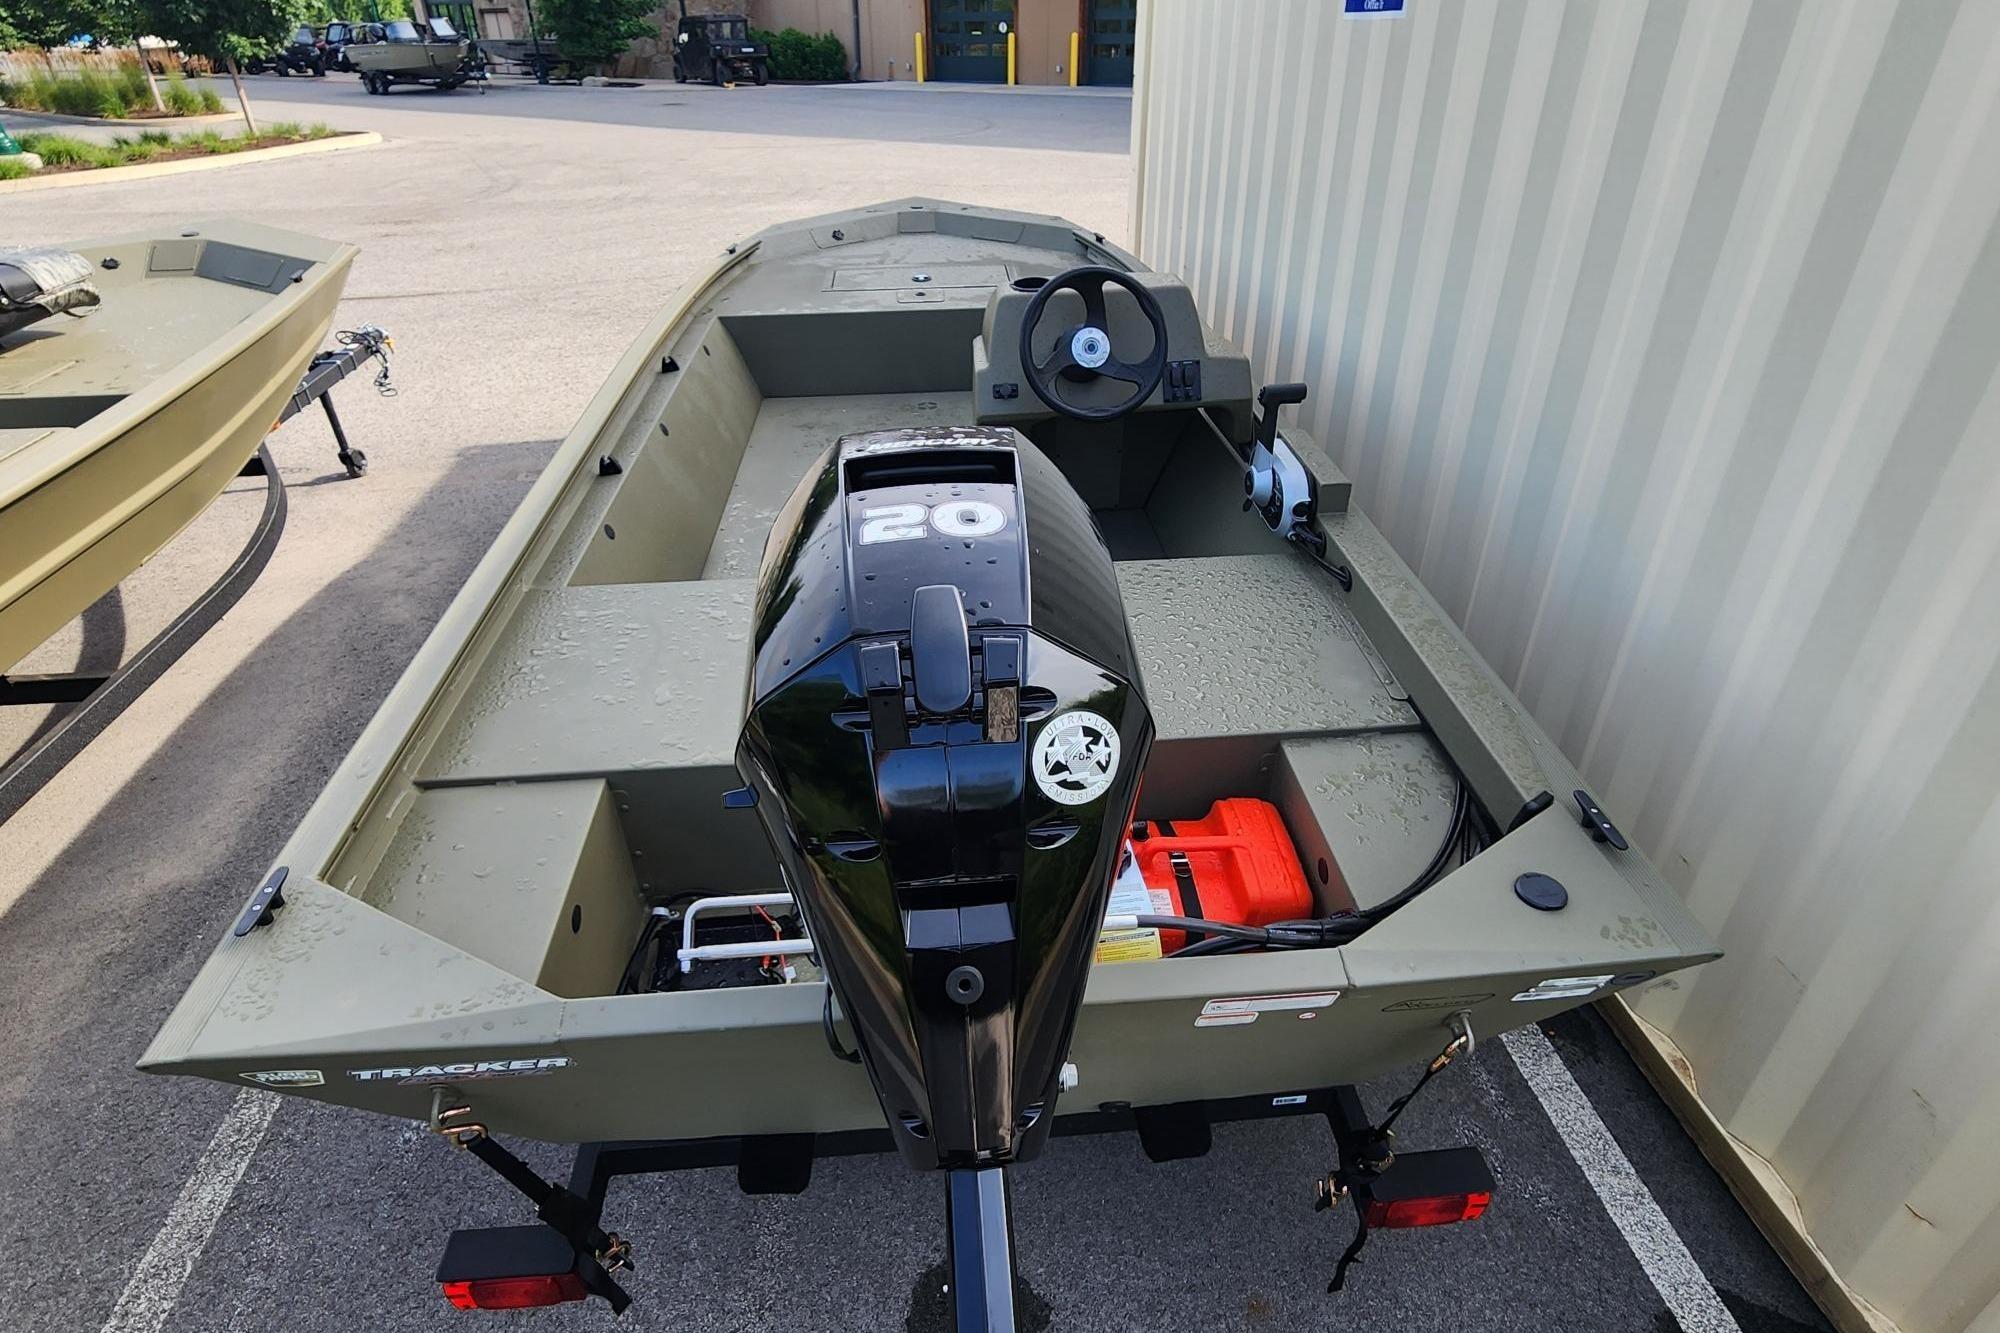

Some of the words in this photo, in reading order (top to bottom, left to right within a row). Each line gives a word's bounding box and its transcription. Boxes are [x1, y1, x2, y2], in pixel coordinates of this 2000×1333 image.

[859, 501, 1007, 545] 20
[1046, 714, 1084, 737] ULTRA
[1094, 717, 1116, 739] LOW
[351, 1057, 570, 1081] TRACKER
